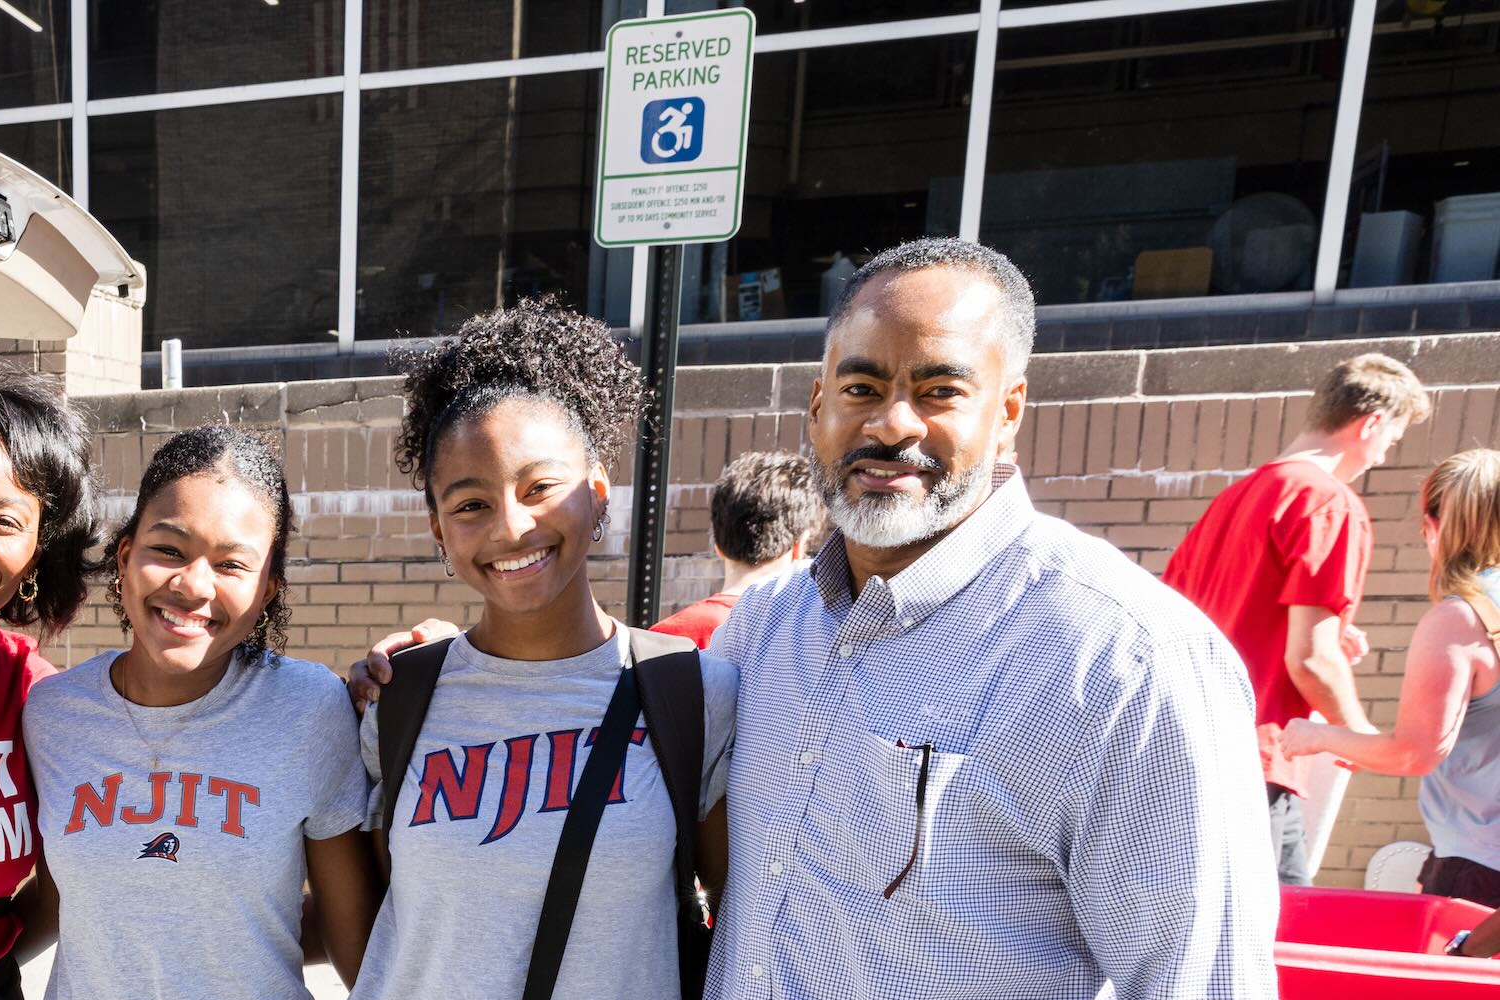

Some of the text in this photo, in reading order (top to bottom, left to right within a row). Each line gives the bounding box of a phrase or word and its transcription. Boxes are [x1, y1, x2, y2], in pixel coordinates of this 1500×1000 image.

[626, 37, 731, 66] RESERVED
[632, 64, 720, 92] PARKING
[660, 210, 693, 220] COMMUNITY
[694, 208, 718, 218] SERVICE
[64, 772, 260, 838] NJIT
